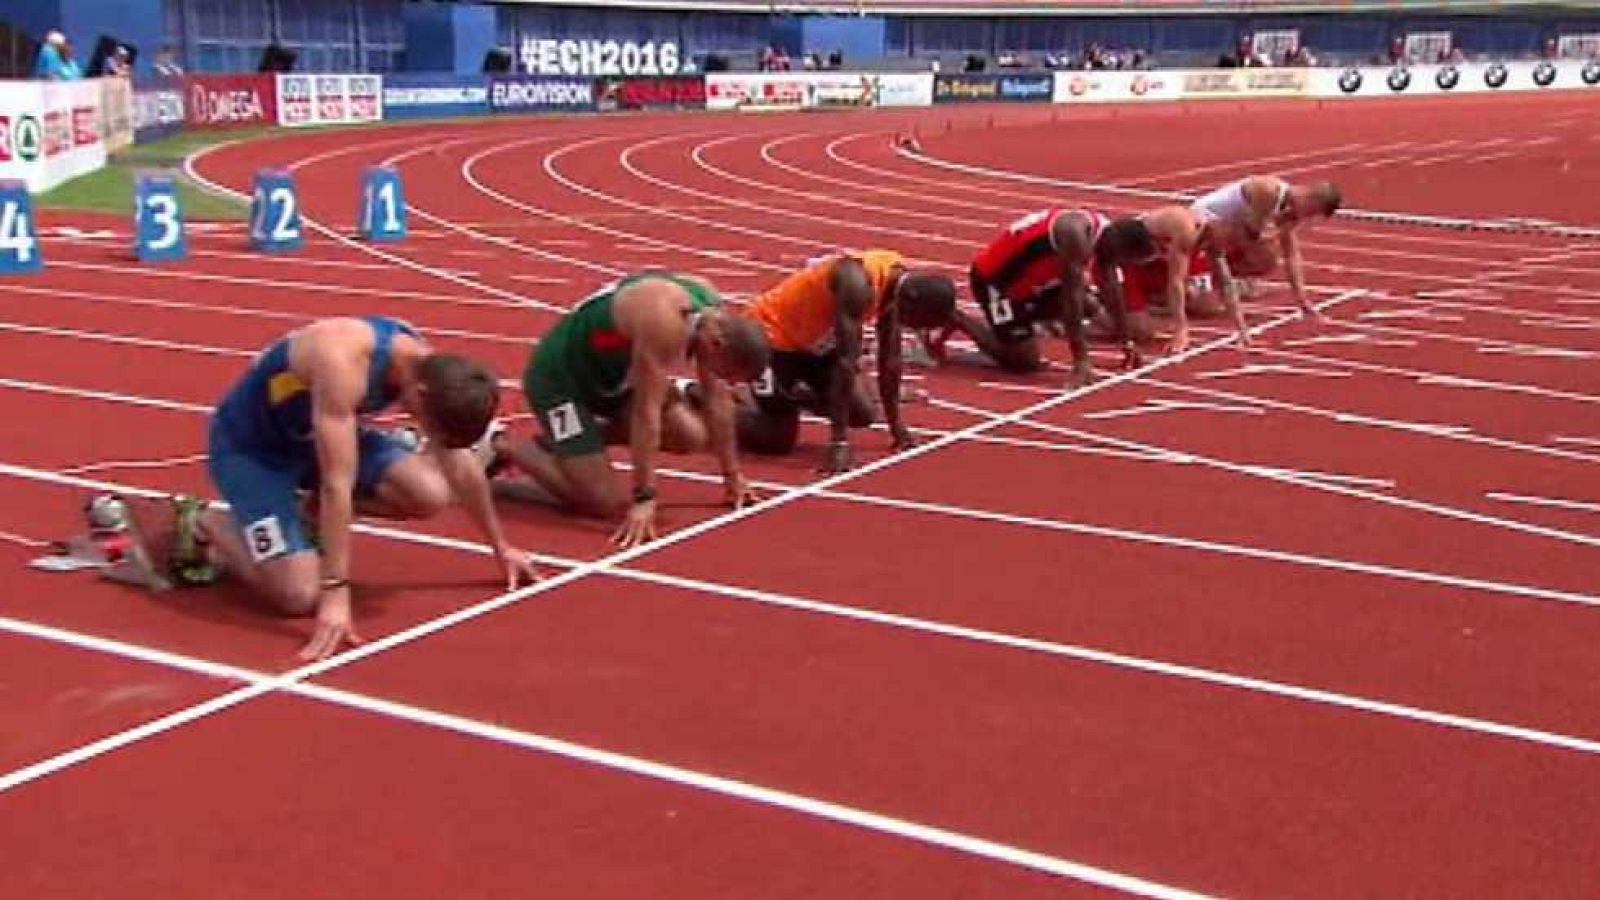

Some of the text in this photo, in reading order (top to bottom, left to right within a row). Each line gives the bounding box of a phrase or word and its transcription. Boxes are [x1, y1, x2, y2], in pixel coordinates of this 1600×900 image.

[521, 35, 679, 75] #ECH2016
[208, 89, 263, 122] OMEGA
[492, 81, 591, 106] EUROVISION
[0, 200, 34, 263] 4
[147, 194, 180, 250] 3
[270, 188, 298, 240] 2
[378, 182, 401, 232] 1
